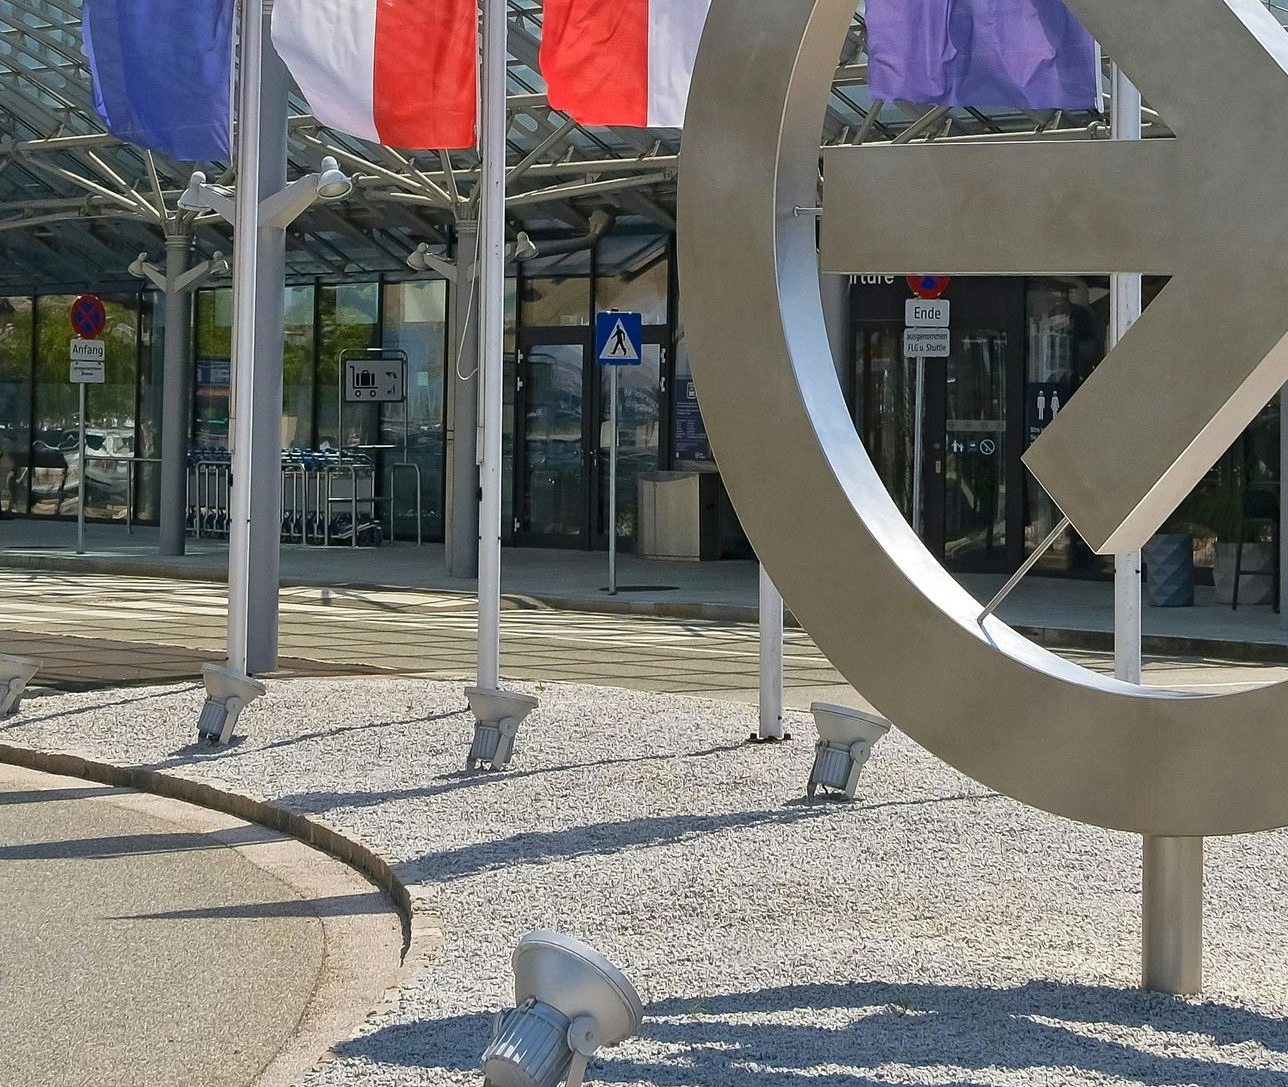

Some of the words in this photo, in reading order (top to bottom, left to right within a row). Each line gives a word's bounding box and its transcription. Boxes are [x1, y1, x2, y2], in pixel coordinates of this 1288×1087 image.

[914, 306, 941, 319] Ende
[906, 333, 948, 341] ausgenommen
[72, 344, 103, 357] Anfang
